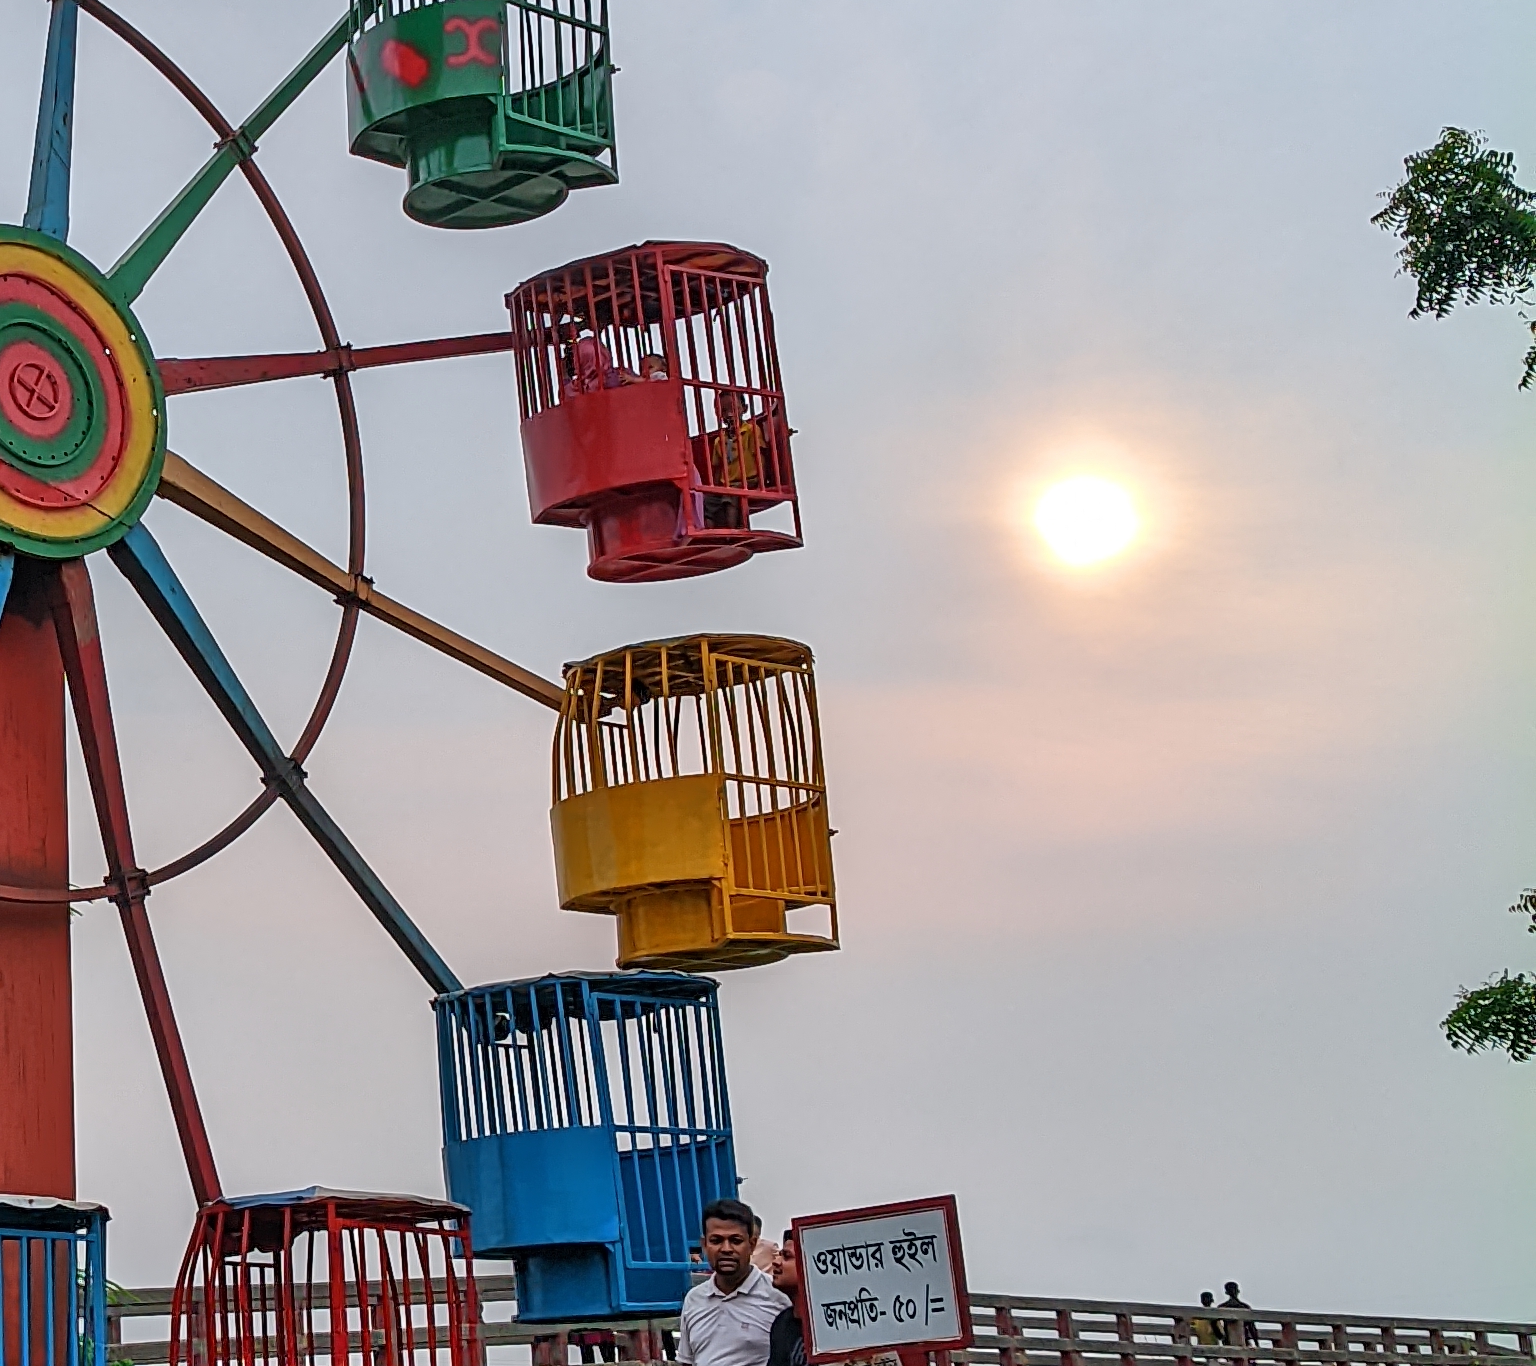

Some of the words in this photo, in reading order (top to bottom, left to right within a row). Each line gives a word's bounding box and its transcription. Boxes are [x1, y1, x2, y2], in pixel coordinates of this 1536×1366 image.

[813, 1242, 884, 1276] ওয়ান্ডার
[889, 1228, 938, 1273] হুইল
[892, 1294, 917, 1323] ৫০
